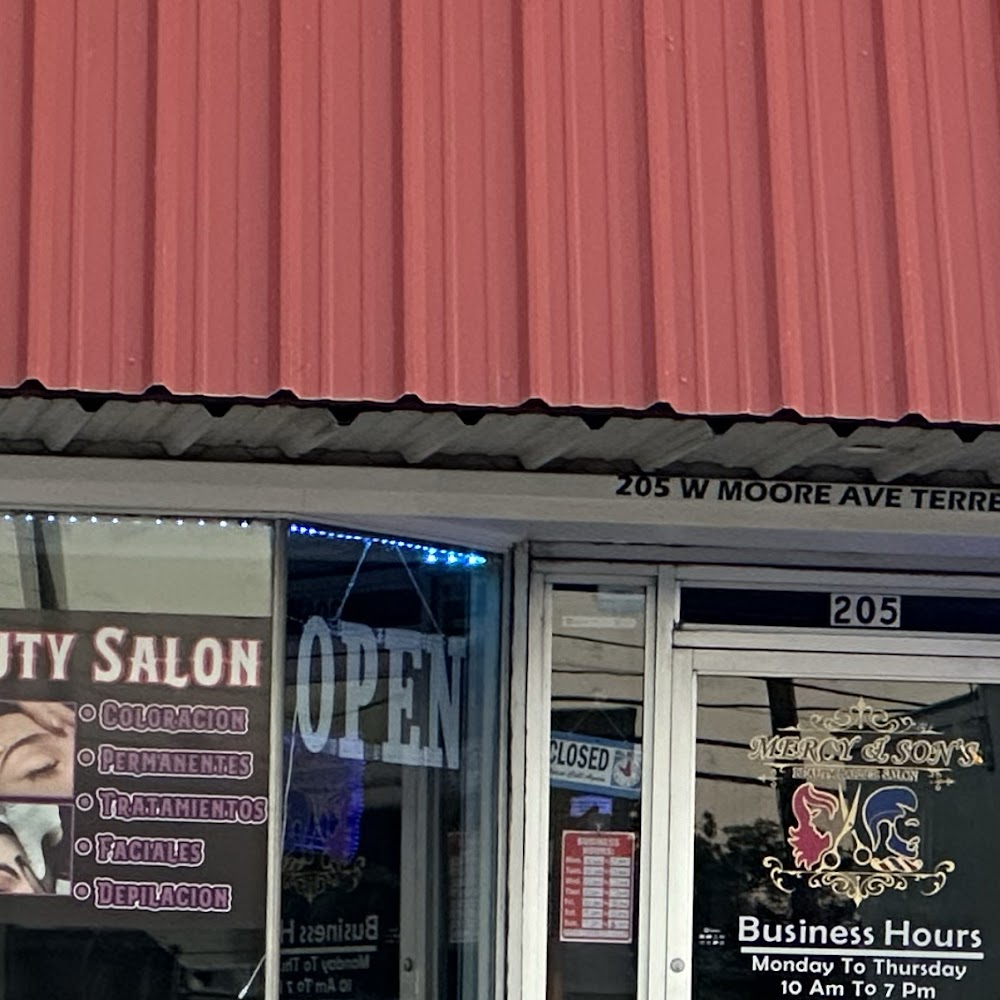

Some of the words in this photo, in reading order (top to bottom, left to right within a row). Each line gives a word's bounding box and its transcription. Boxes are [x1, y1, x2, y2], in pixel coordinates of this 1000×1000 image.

[616, 474, 670, 498] 205
[680, 478, 709, 498] W
[718, 481, 831, 504] MOORE
[838, 486, 903, 509] AVE
[833, 596, 899, 625] 205
[296, 615, 467, 770] OPEN
[550, 740, 609, 771] CLOSED
[748, 734, 862, 763] MERCY
[738, 915, 874, 946] Business
[884, 920, 982, 948] Hours
[752, 955, 834, 976] Monday
[841, 957, 866, 975] To
[873, 959, 967, 980] Thursday
[781, 980, 802, 995] 10
[809, 980, 844, 997] Am
[852, 980, 877, 997] To
[884, 983, 895, 998] 7
[902, 982, 936, 999] Pm
